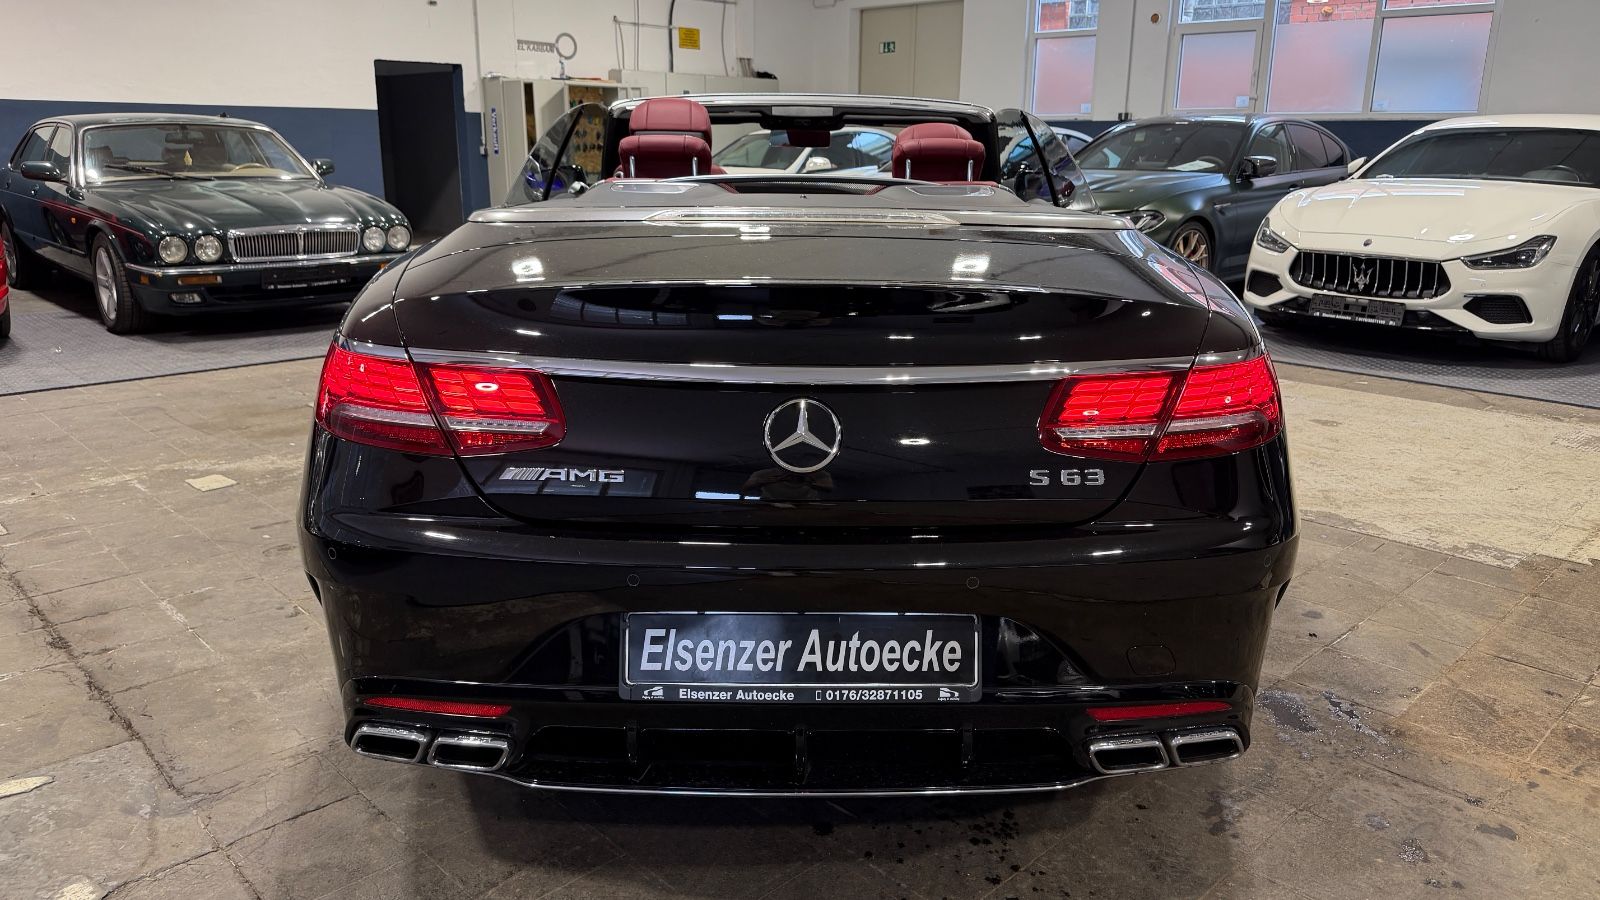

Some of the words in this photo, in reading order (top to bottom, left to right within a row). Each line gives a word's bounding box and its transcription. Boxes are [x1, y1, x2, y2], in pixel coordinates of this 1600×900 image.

[538, 467, 625, 483] AMG
[1029, 469, 1050, 486] S
[1060, 468, 1106, 486] 63
[639, 628, 792, 673] Elsenzer
[796, 628, 963, 673] Autoecke
[678, 688, 733, 701] Elsenzer
[736, 689, 795, 701] Autoecke
[825, 690, 923, 701] 0176/32871105
